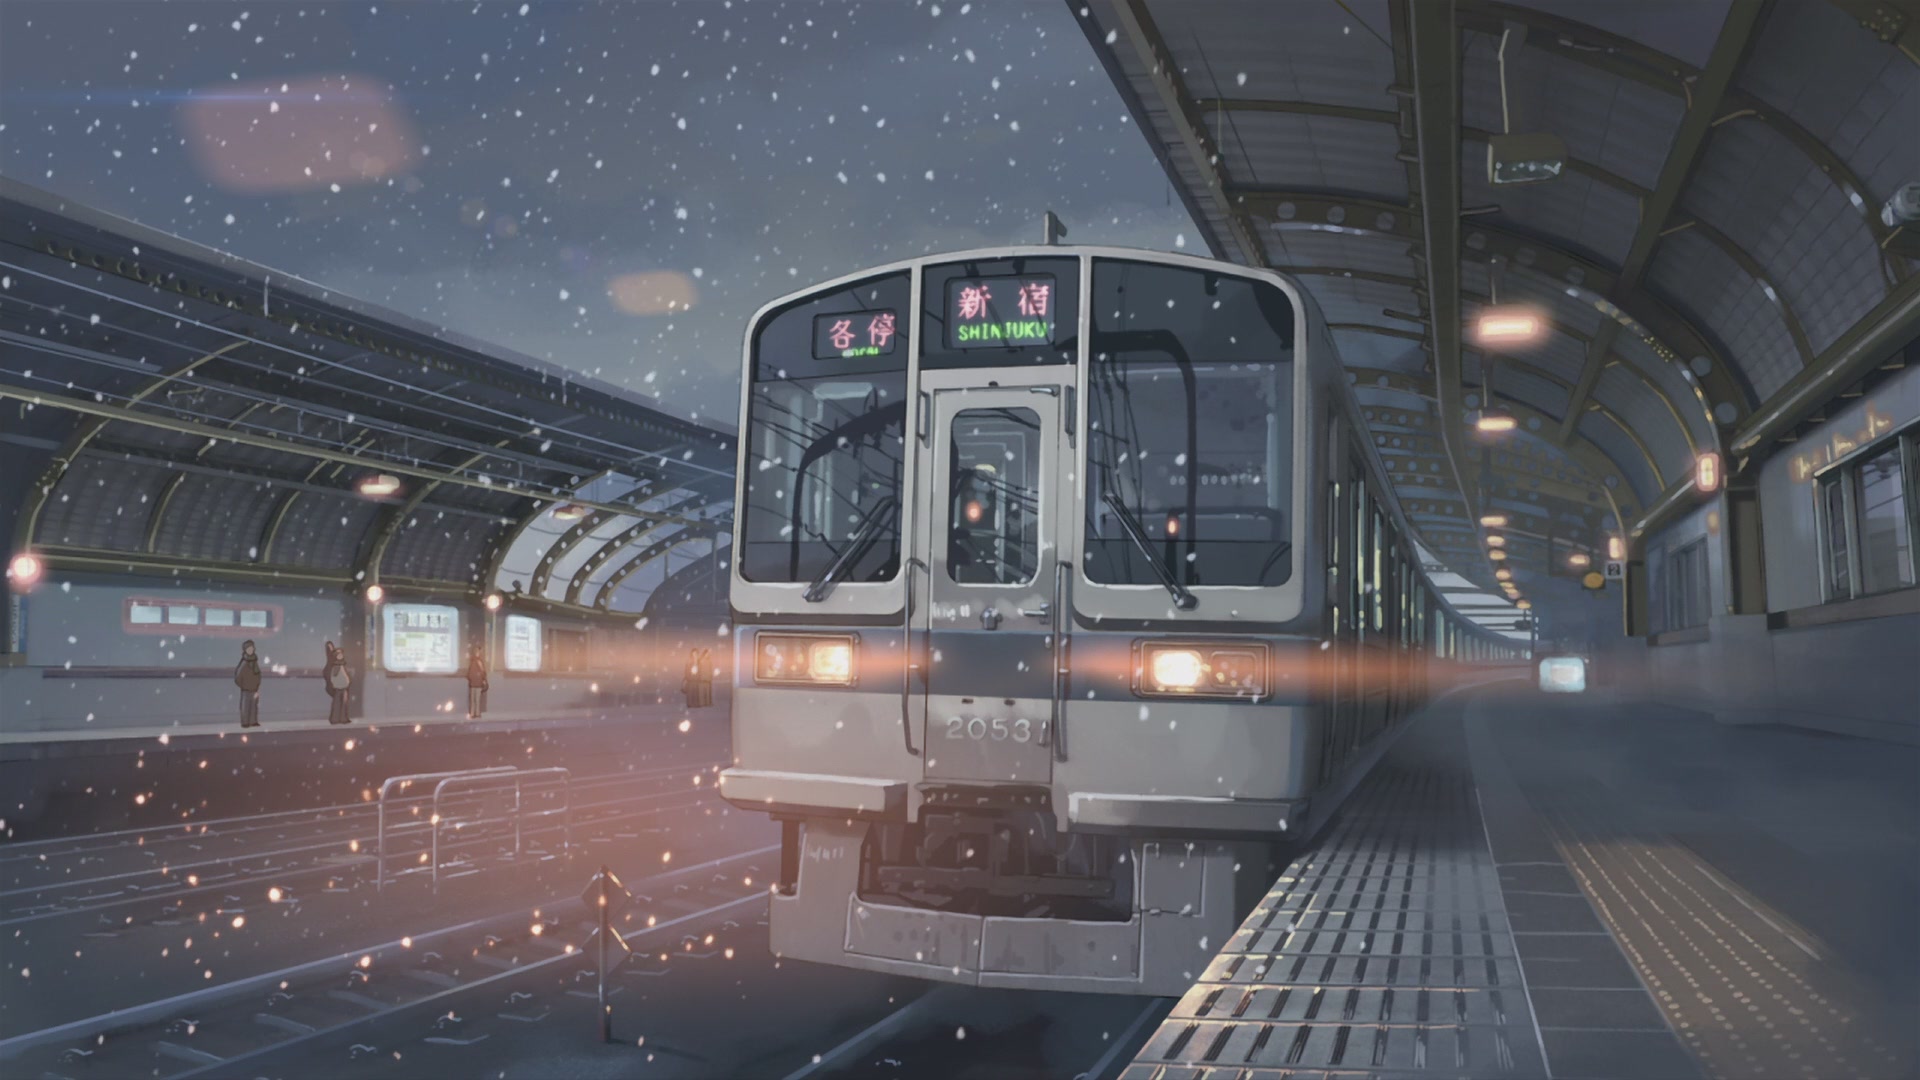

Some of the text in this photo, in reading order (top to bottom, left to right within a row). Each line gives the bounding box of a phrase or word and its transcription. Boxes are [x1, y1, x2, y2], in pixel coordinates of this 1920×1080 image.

[958, 283, 1049, 319] 新宿
[830, 314, 895, 349] 各停
[958, 321, 1047, 341] SHINJUKU
